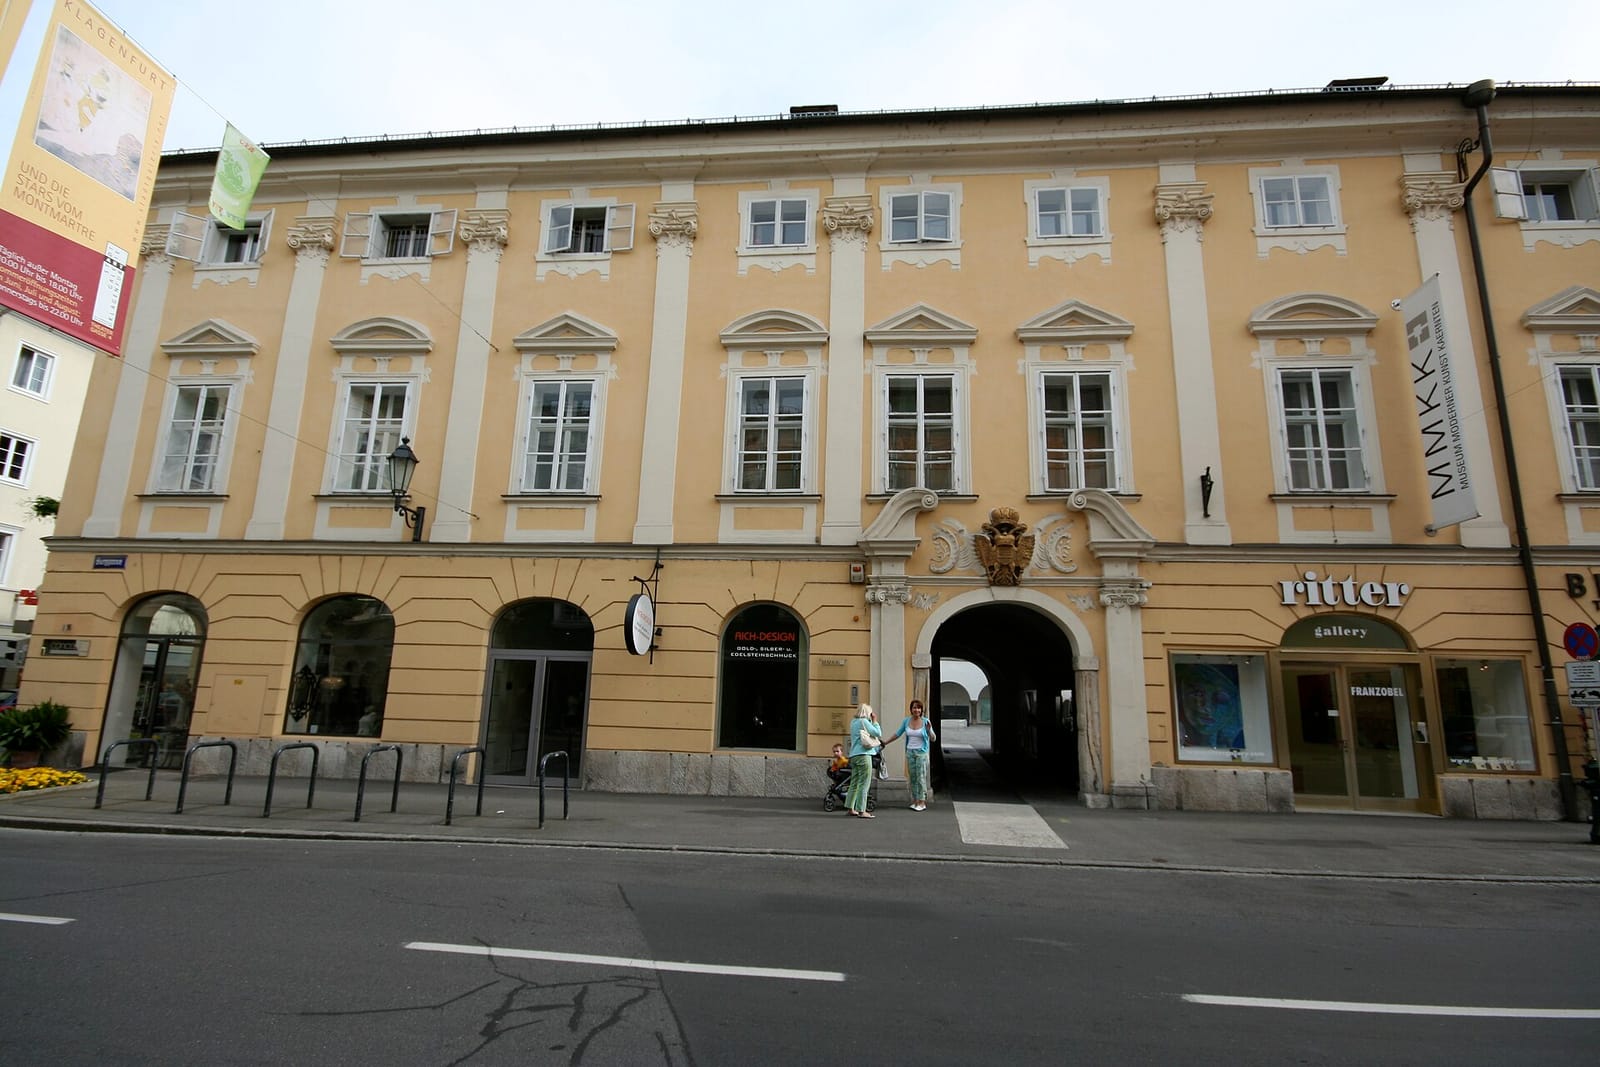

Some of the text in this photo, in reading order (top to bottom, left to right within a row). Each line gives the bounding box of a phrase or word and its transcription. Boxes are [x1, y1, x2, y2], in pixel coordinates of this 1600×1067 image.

[63, 0, 168, 91] KLAGENFURT
[16, 174, 84, 220] STARS VOM
[20, 161, 71, 199] UND DIE
[13, 186, 97, 241] MONTMARTRE
[0, 265, 79, 307] ommeröffnungszeiten
[20, 264, 34, 277] Uhr
[36, 272, 47, 284] bis
[49, 279, 69, 295] 18.00
[50, 271, 78, 291] Montag
[38, 293, 53, 305] und
[38, 300, 49, 312] bis
[1431, 300, 1470, 490] MUSEUM MODERNER KUNST KAERNTEN
[1411, 348, 1455, 499] MMKK
[1279, 570, 1410, 607] ritter
[735, 631, 796, 642] RICH-DESIGN
[1314, 626, 1368, 639] gallery
[1351, 686, 1404, 697] FRANZOBEL
